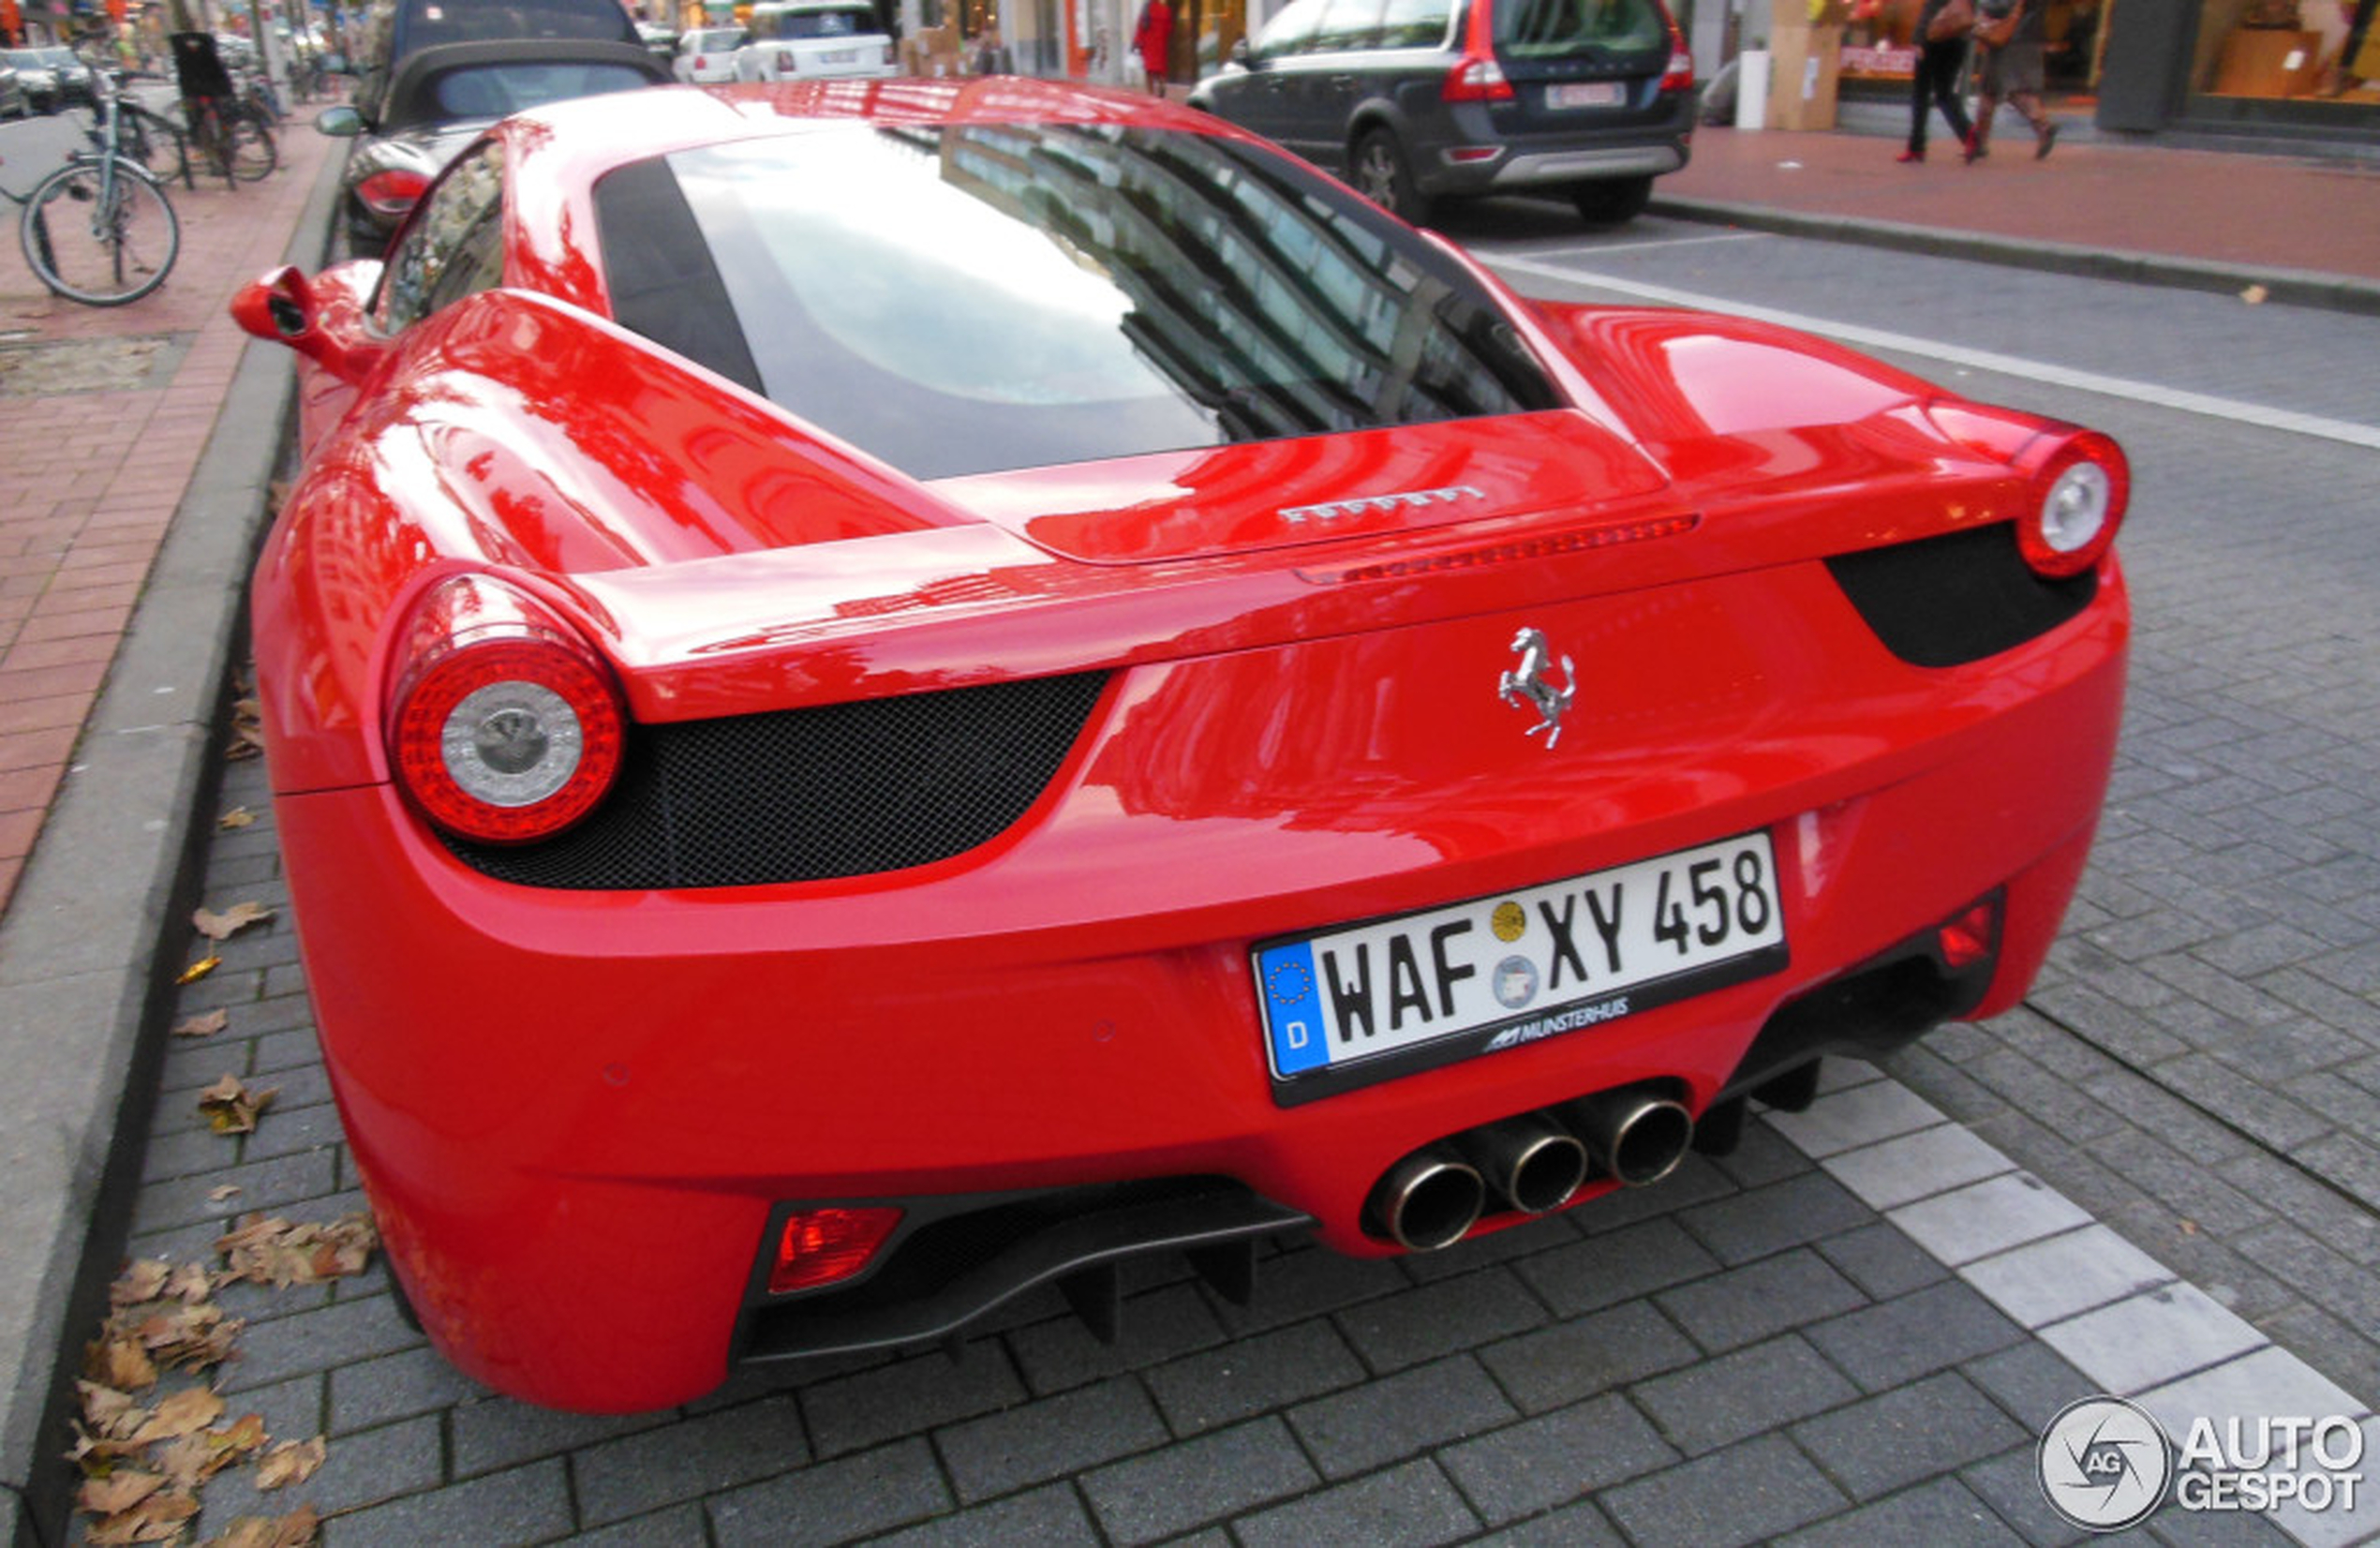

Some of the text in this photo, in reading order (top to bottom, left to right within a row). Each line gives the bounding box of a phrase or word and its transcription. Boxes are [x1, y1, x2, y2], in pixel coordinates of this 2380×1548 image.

[1322, 849, 1771, 1043] WAF XY 458
[1287, 1020, 1309, 1049] D
[1519, 997, 1629, 1043] MUNSTERHUIS
